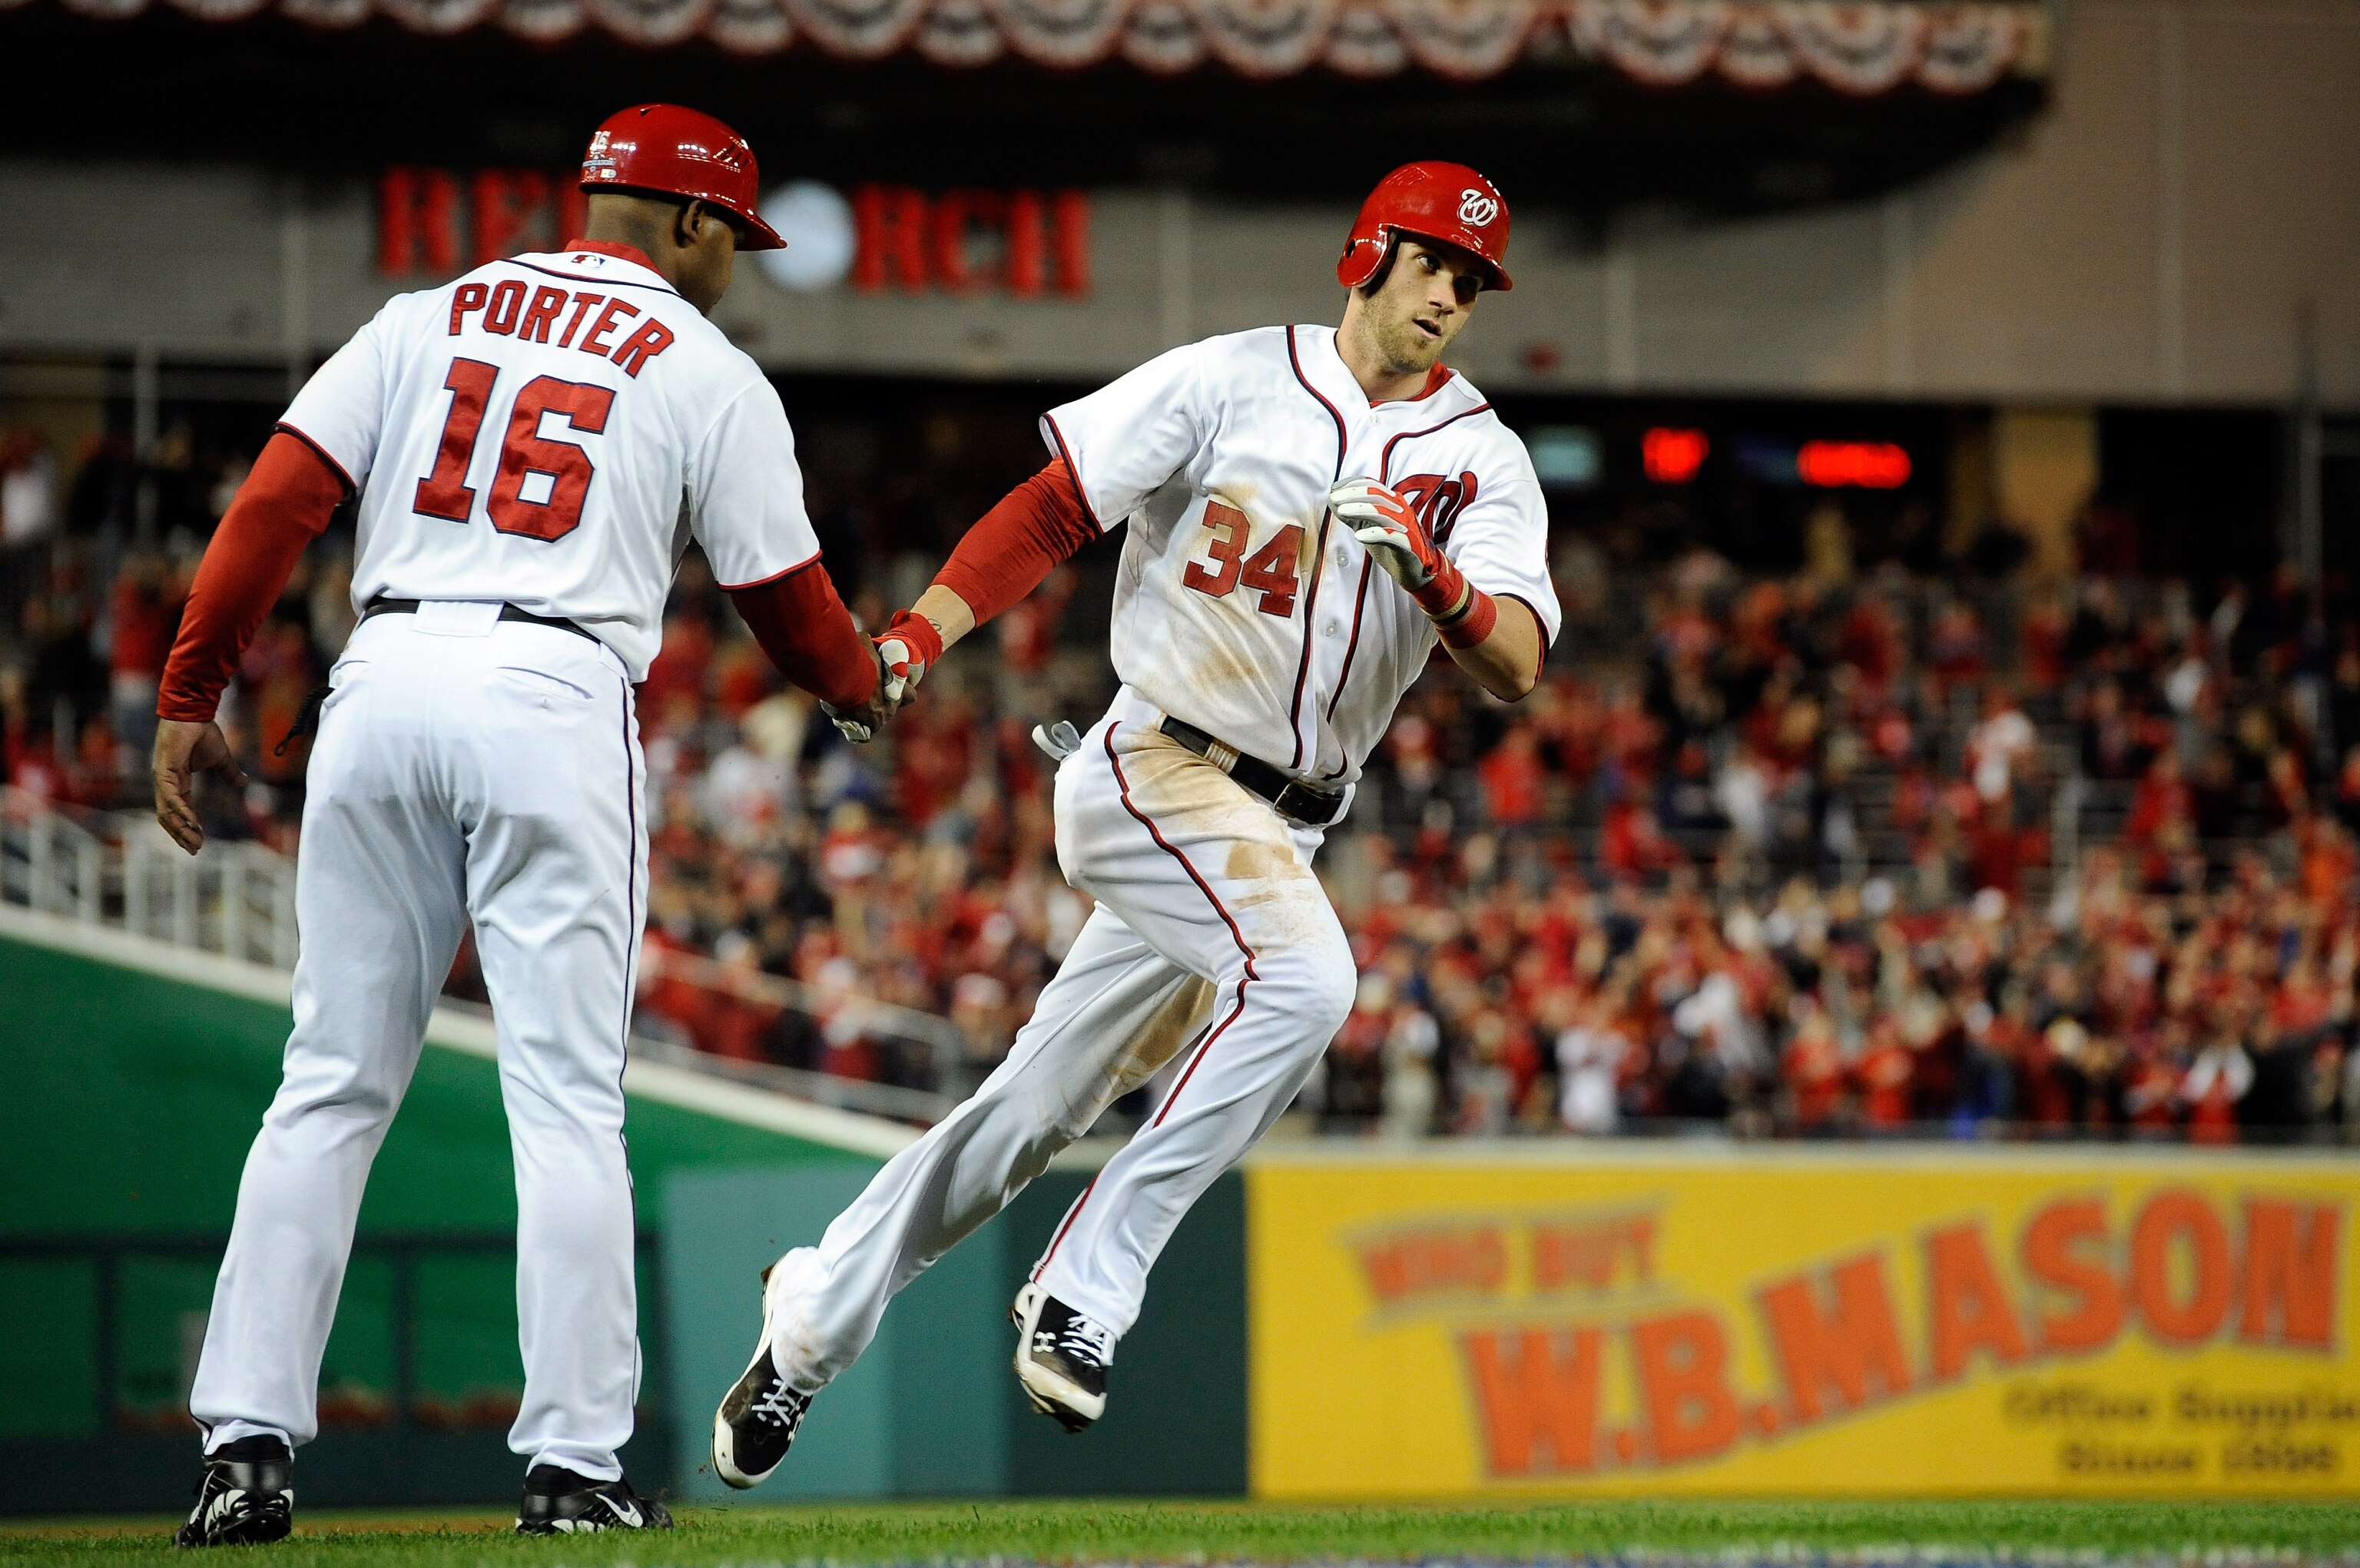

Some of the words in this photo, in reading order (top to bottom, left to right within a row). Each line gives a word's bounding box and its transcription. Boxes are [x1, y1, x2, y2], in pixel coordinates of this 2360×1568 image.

[449, 279, 675, 380] PORTER
[412, 356, 618, 543] 16
[1182, 499, 1305, 618] 34
